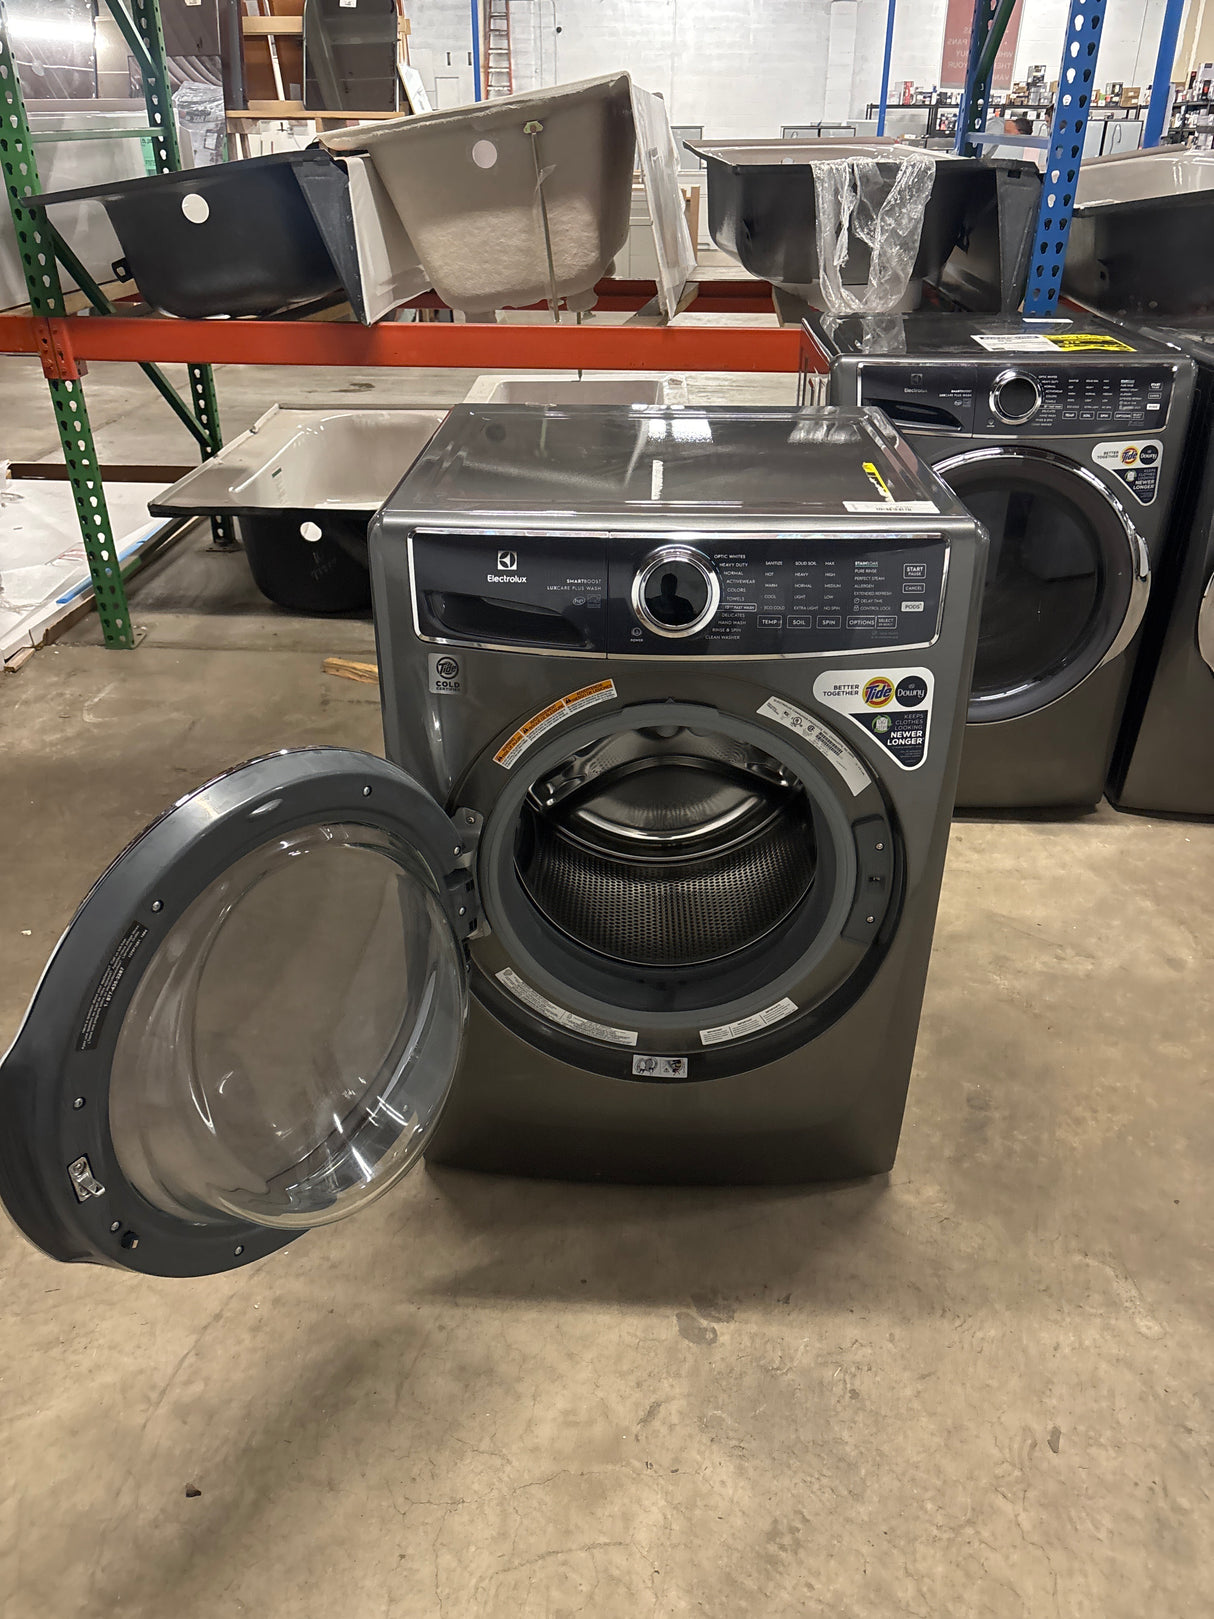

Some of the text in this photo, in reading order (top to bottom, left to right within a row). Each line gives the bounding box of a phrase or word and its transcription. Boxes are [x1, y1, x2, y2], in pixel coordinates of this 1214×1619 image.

[488, 575, 527, 583] Electrolux
[439, 661, 456, 675] Tide
[865, 684, 892, 703] Tide
[898, 689, 925, 698] Downy
